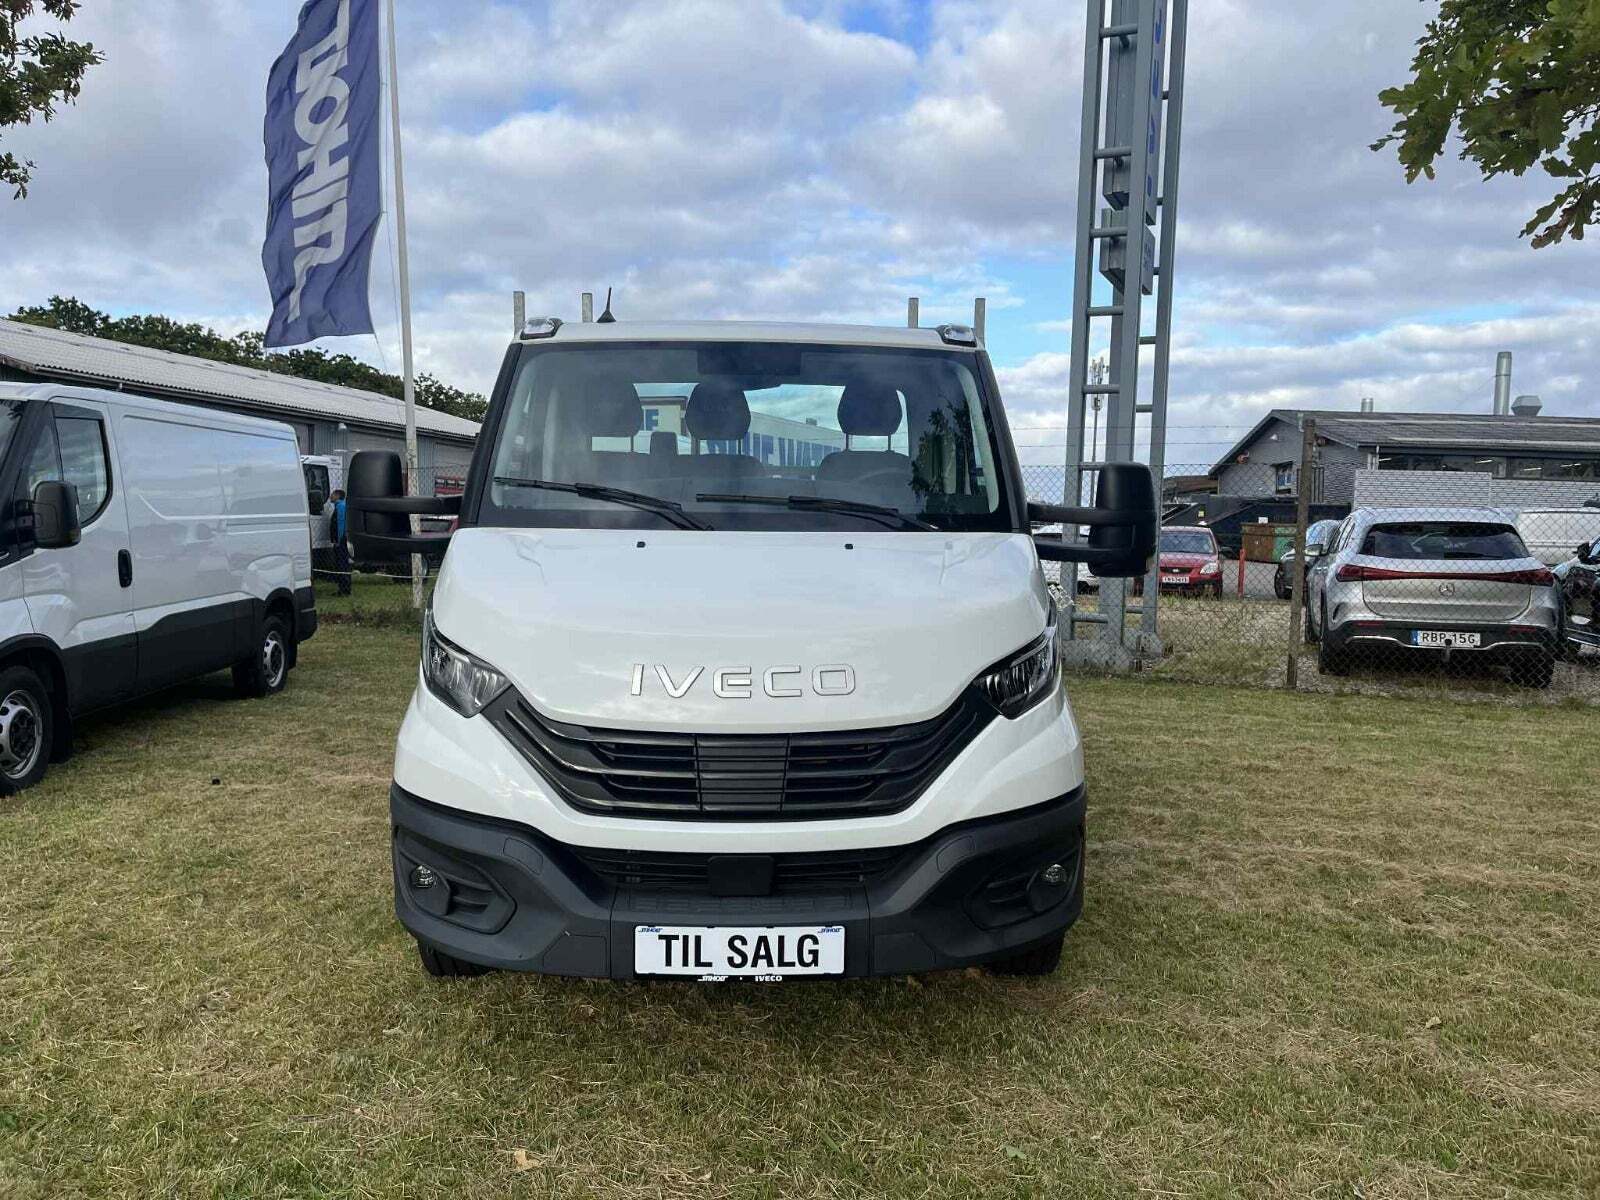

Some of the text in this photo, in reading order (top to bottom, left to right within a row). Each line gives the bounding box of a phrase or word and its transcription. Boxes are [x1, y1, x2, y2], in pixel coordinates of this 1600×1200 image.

[1422, 632, 1475, 644] RBP 15G
[631, 663, 856, 698] IVECO
[658, 934, 819, 969] TIL SALG
